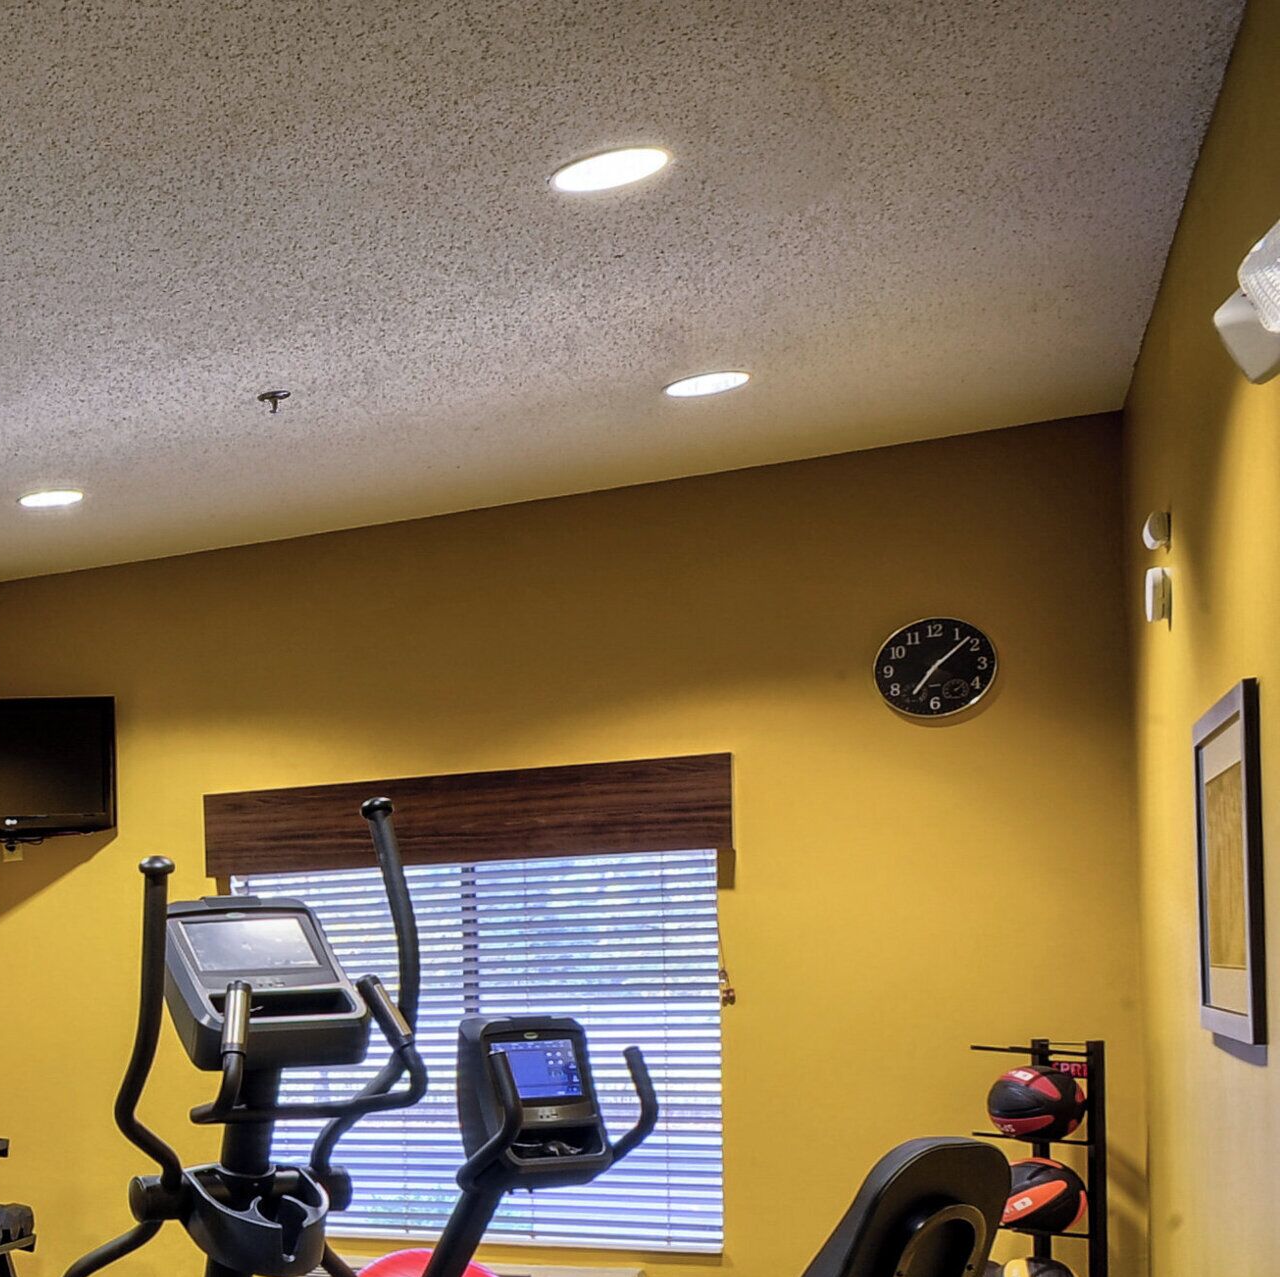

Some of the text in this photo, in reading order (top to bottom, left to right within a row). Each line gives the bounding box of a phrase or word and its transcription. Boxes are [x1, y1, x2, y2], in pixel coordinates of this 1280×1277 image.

[926, 624, 943, 638] 12
[954, 628, 960, 640] 1
[906, 632, 920, 645] 11
[969, 638, 980, 651] 2
[890, 645, 906, 659] 10
[977, 656, 988, 670] 3
[883, 665, 894, 678] 9
[970, 676, 981, 689] 4
[890, 683, 900, 696] 8
[929, 697, 941, 710] 6
